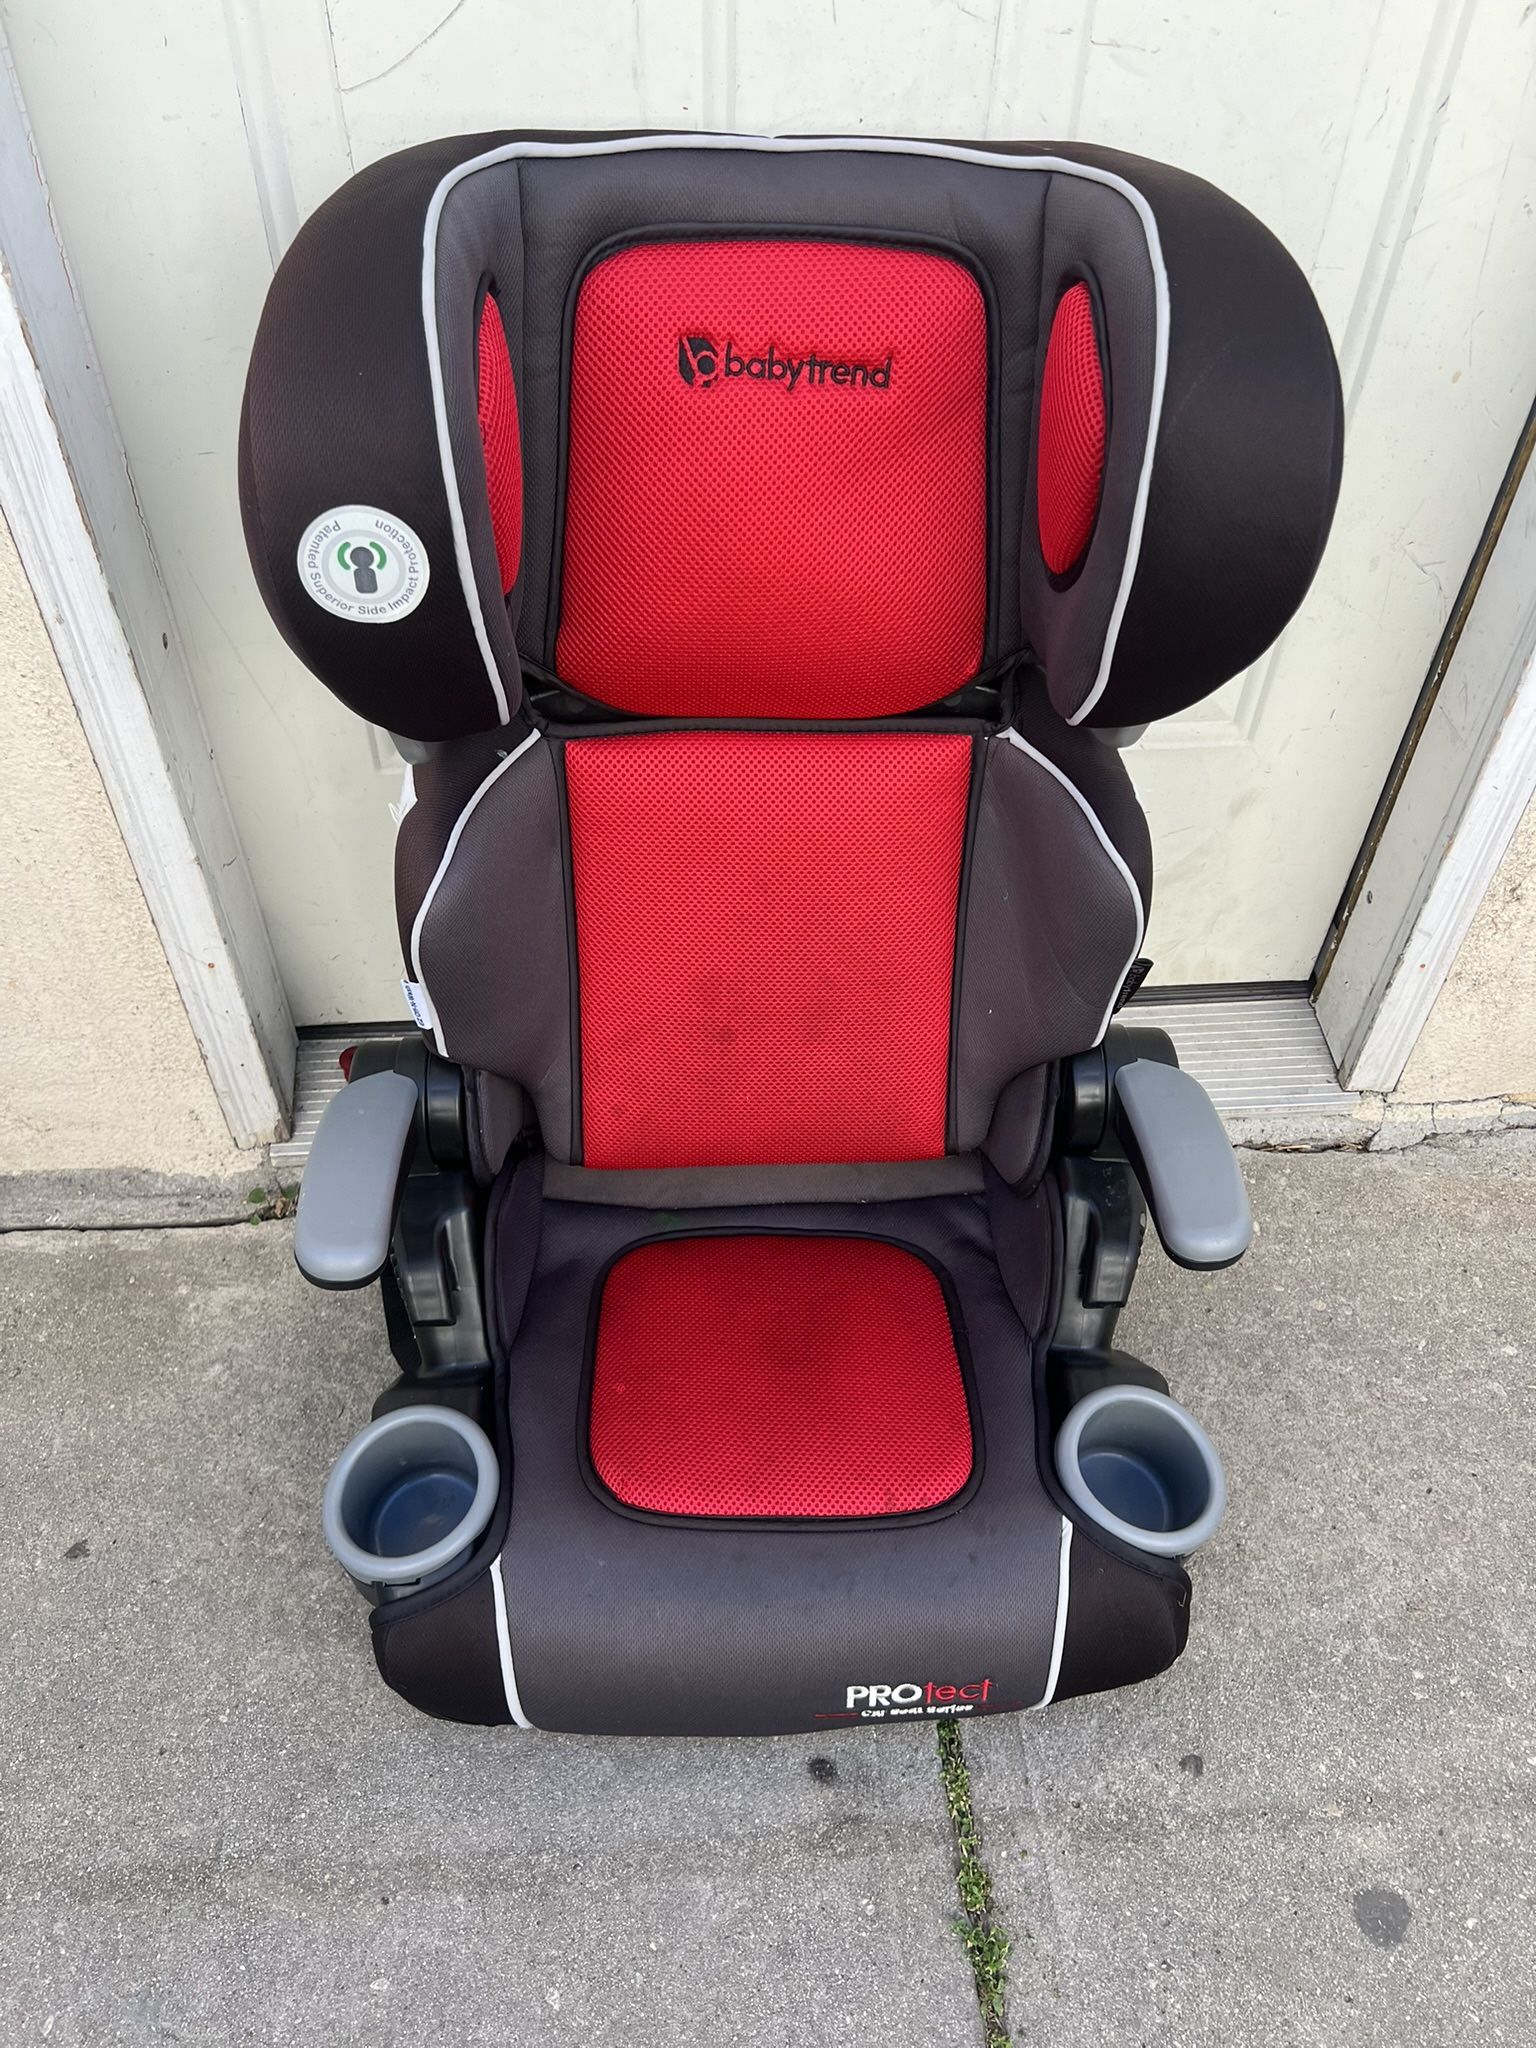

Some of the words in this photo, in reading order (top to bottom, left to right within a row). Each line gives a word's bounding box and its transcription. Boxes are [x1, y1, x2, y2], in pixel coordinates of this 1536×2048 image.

[724, 341, 892, 392] babytrend
[307, 519, 342, 569] Patented
[375, 519, 420, 574] Protection
[310, 572, 355, 613] Superior
[357, 604, 387, 615] Side
[388, 576, 420, 611] Impact
[846, 1679, 992, 1708] PROtect
